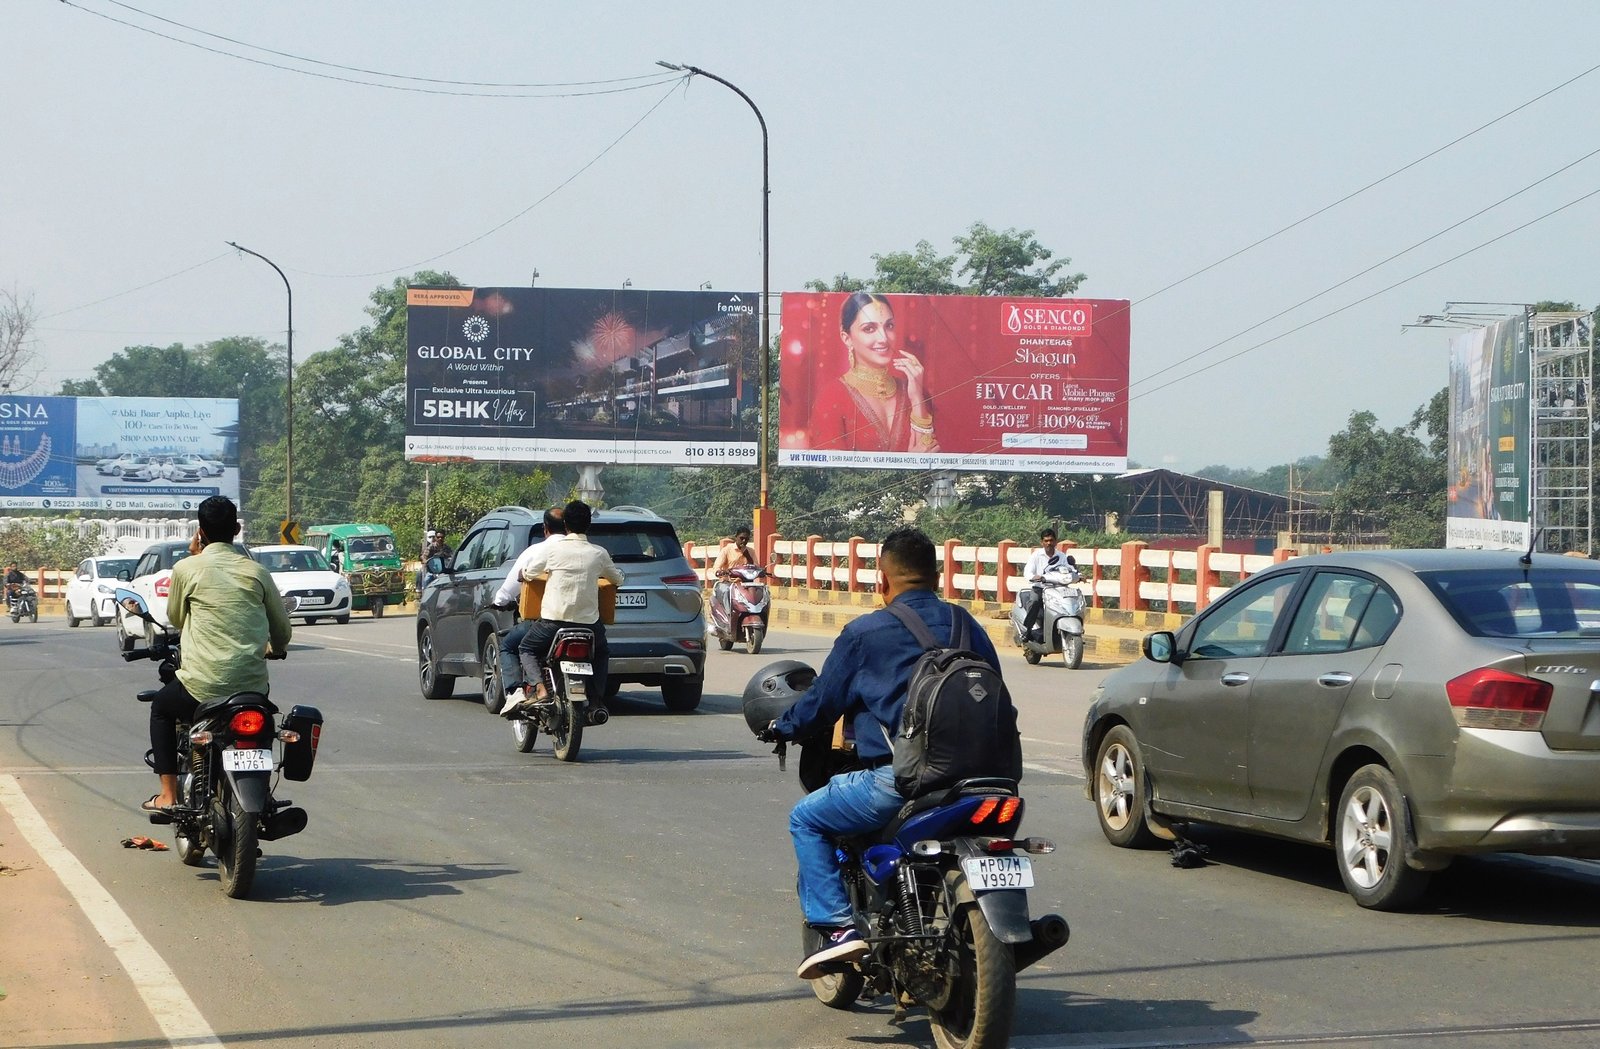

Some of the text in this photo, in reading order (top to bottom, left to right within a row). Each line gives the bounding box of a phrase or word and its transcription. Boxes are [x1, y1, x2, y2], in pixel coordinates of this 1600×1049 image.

[717, 302, 753, 315] fenway
[1023, 308, 1086, 325] SENCO
[1020, 338, 1073, 346] DHANTERAS
[417, 345, 534, 361] GLOBAL CITY
[1014, 348, 1077, 367] Shagun
[454, 363, 479, 371] World
[480, 363, 505, 371] Within
[432, 386, 464, 394] Exclusive
[1062, 388, 1116, 398] Mobile Phones
[422, 398, 527, 423] 5BHK Villas
[1016, 413, 1031, 421] OFF
[685, 447, 756, 458] 810 813 8989
[6, 500, 35, 508] Gwalior
[53, 500, 75, 508] 95223
[115, 501, 127, 509] DB
[148, 502, 176, 510] Gwalior
[1533, 665, 1575, 673] CITY
[233, 750, 265, 760] MP07Z
[981, 873, 1022, 888] V9927
